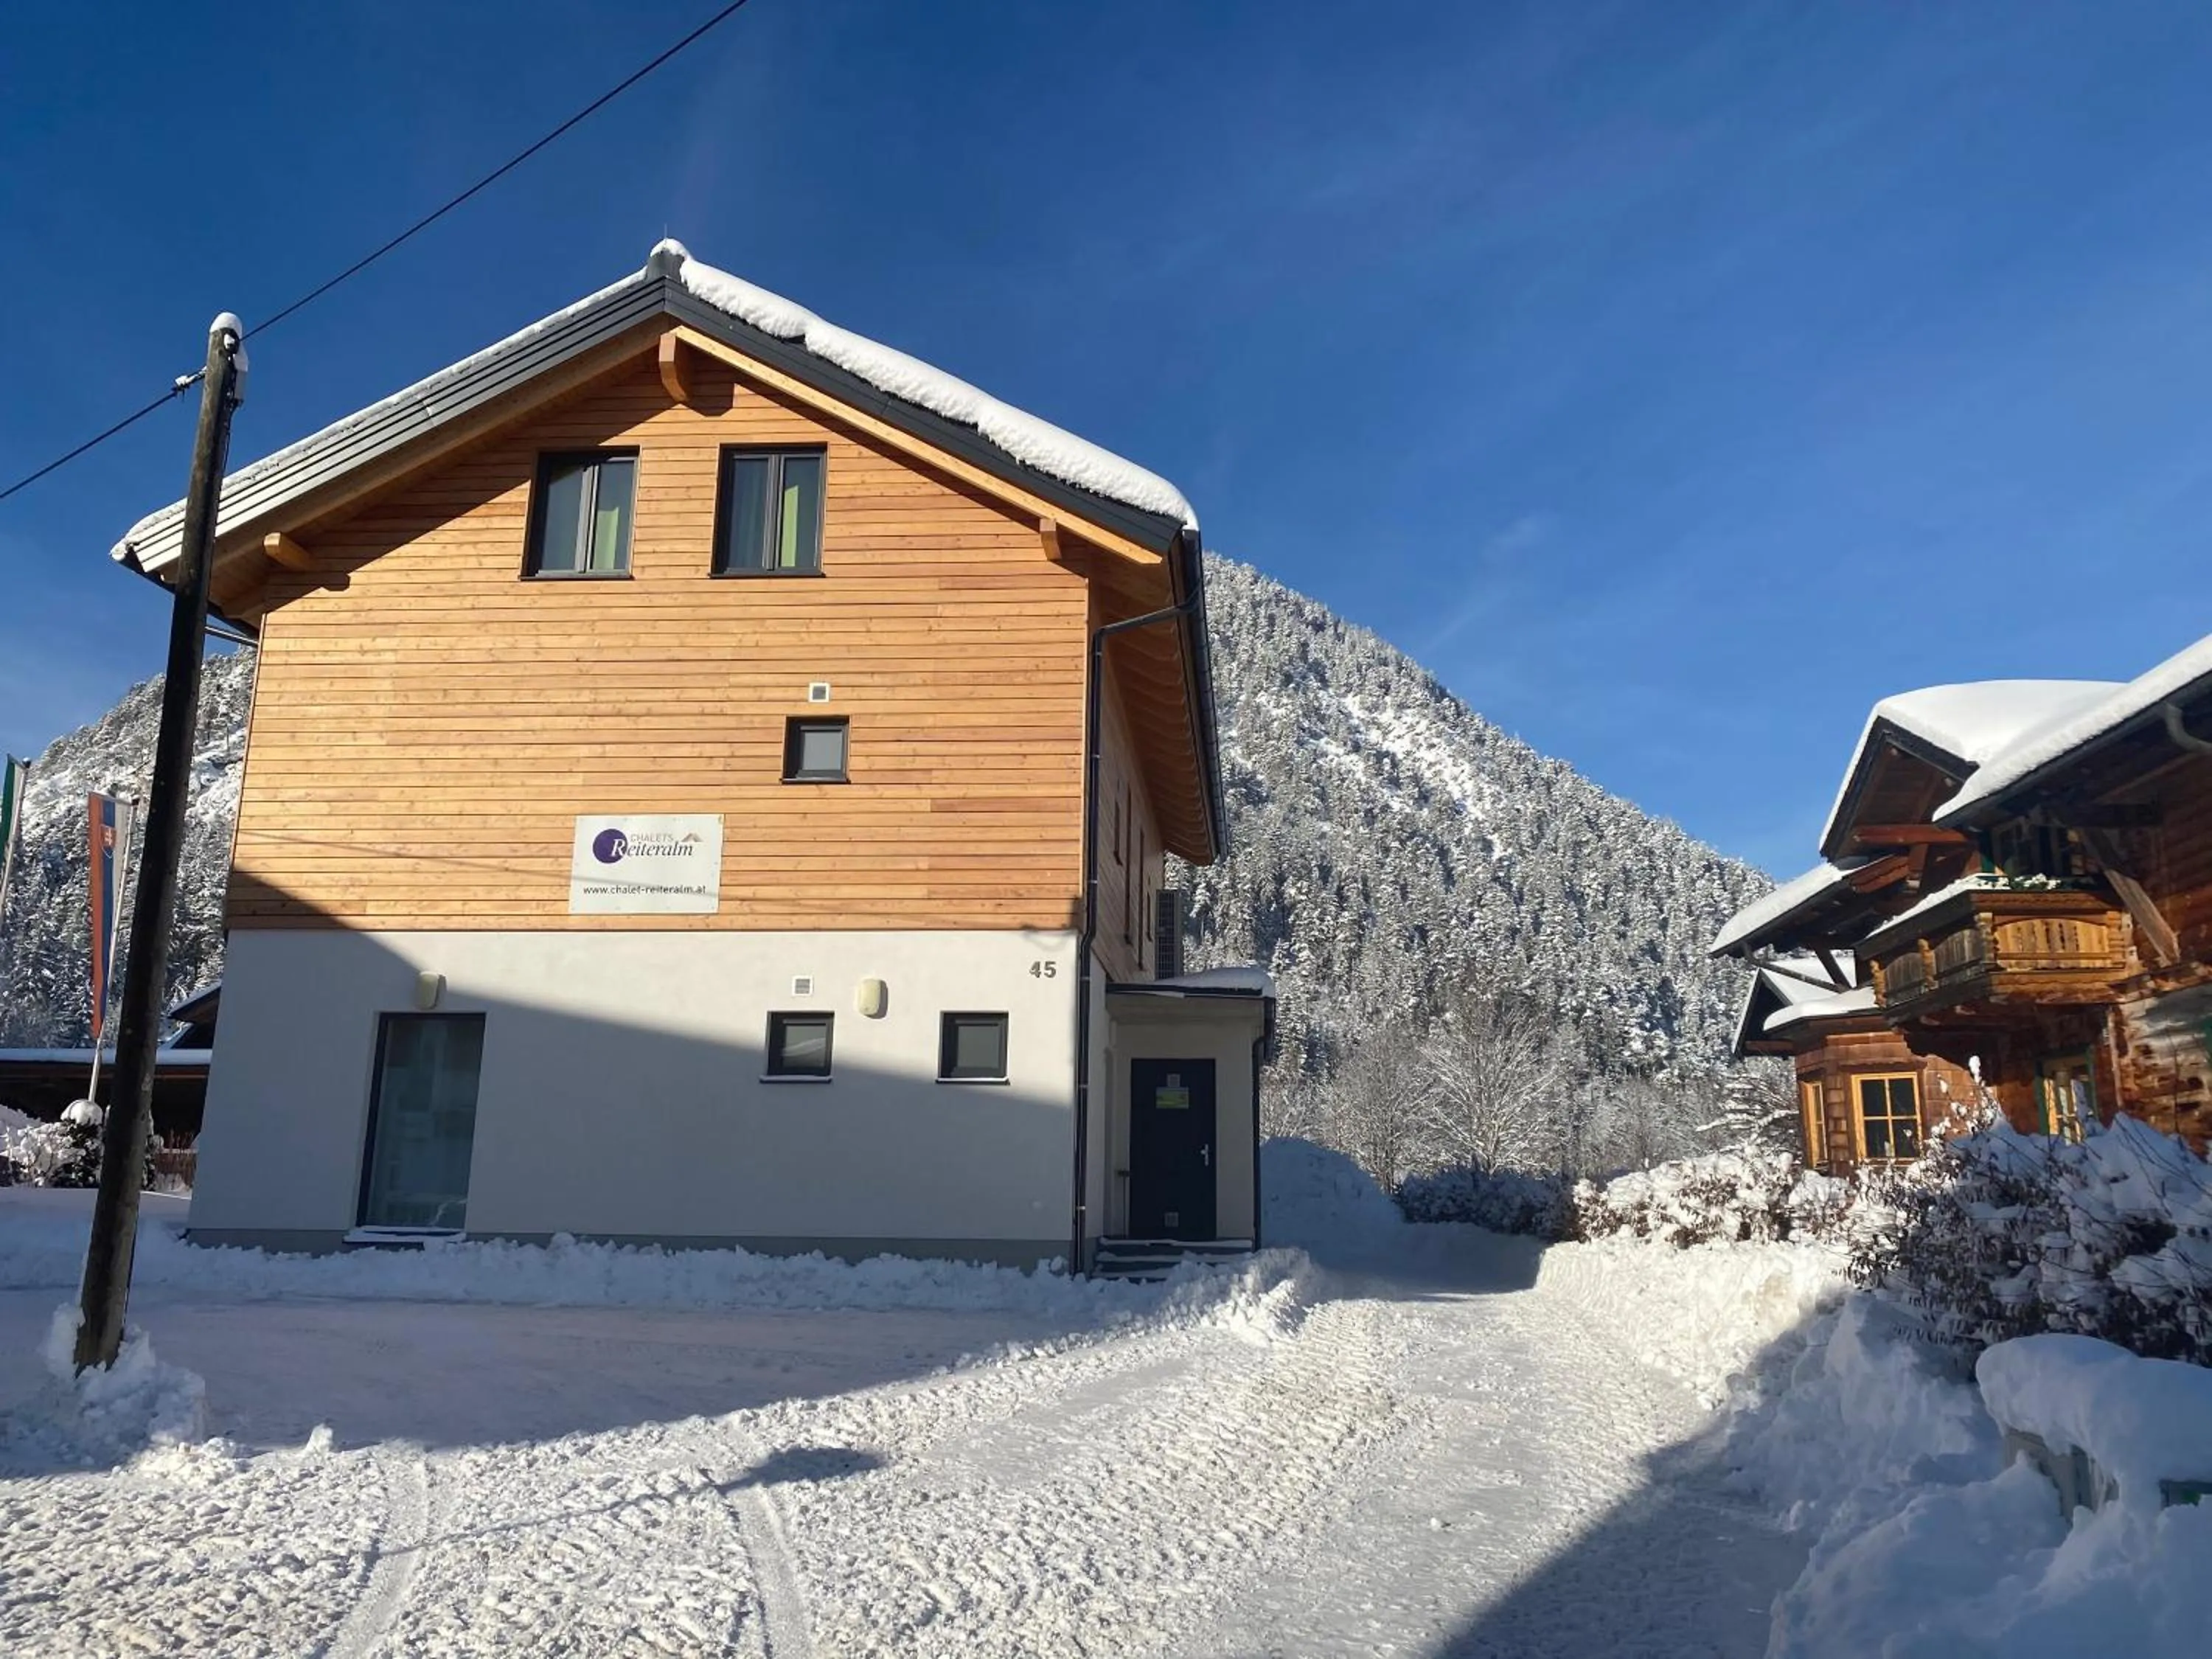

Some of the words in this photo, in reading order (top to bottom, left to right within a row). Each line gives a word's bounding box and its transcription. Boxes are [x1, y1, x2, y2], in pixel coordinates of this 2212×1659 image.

[630, 833, 674, 842] CHALETS
[611, 838, 693, 857] Reiteralm
[583, 885, 706, 895] www.chalet-reiteralm.at
[1029, 961, 1057, 978] 45
